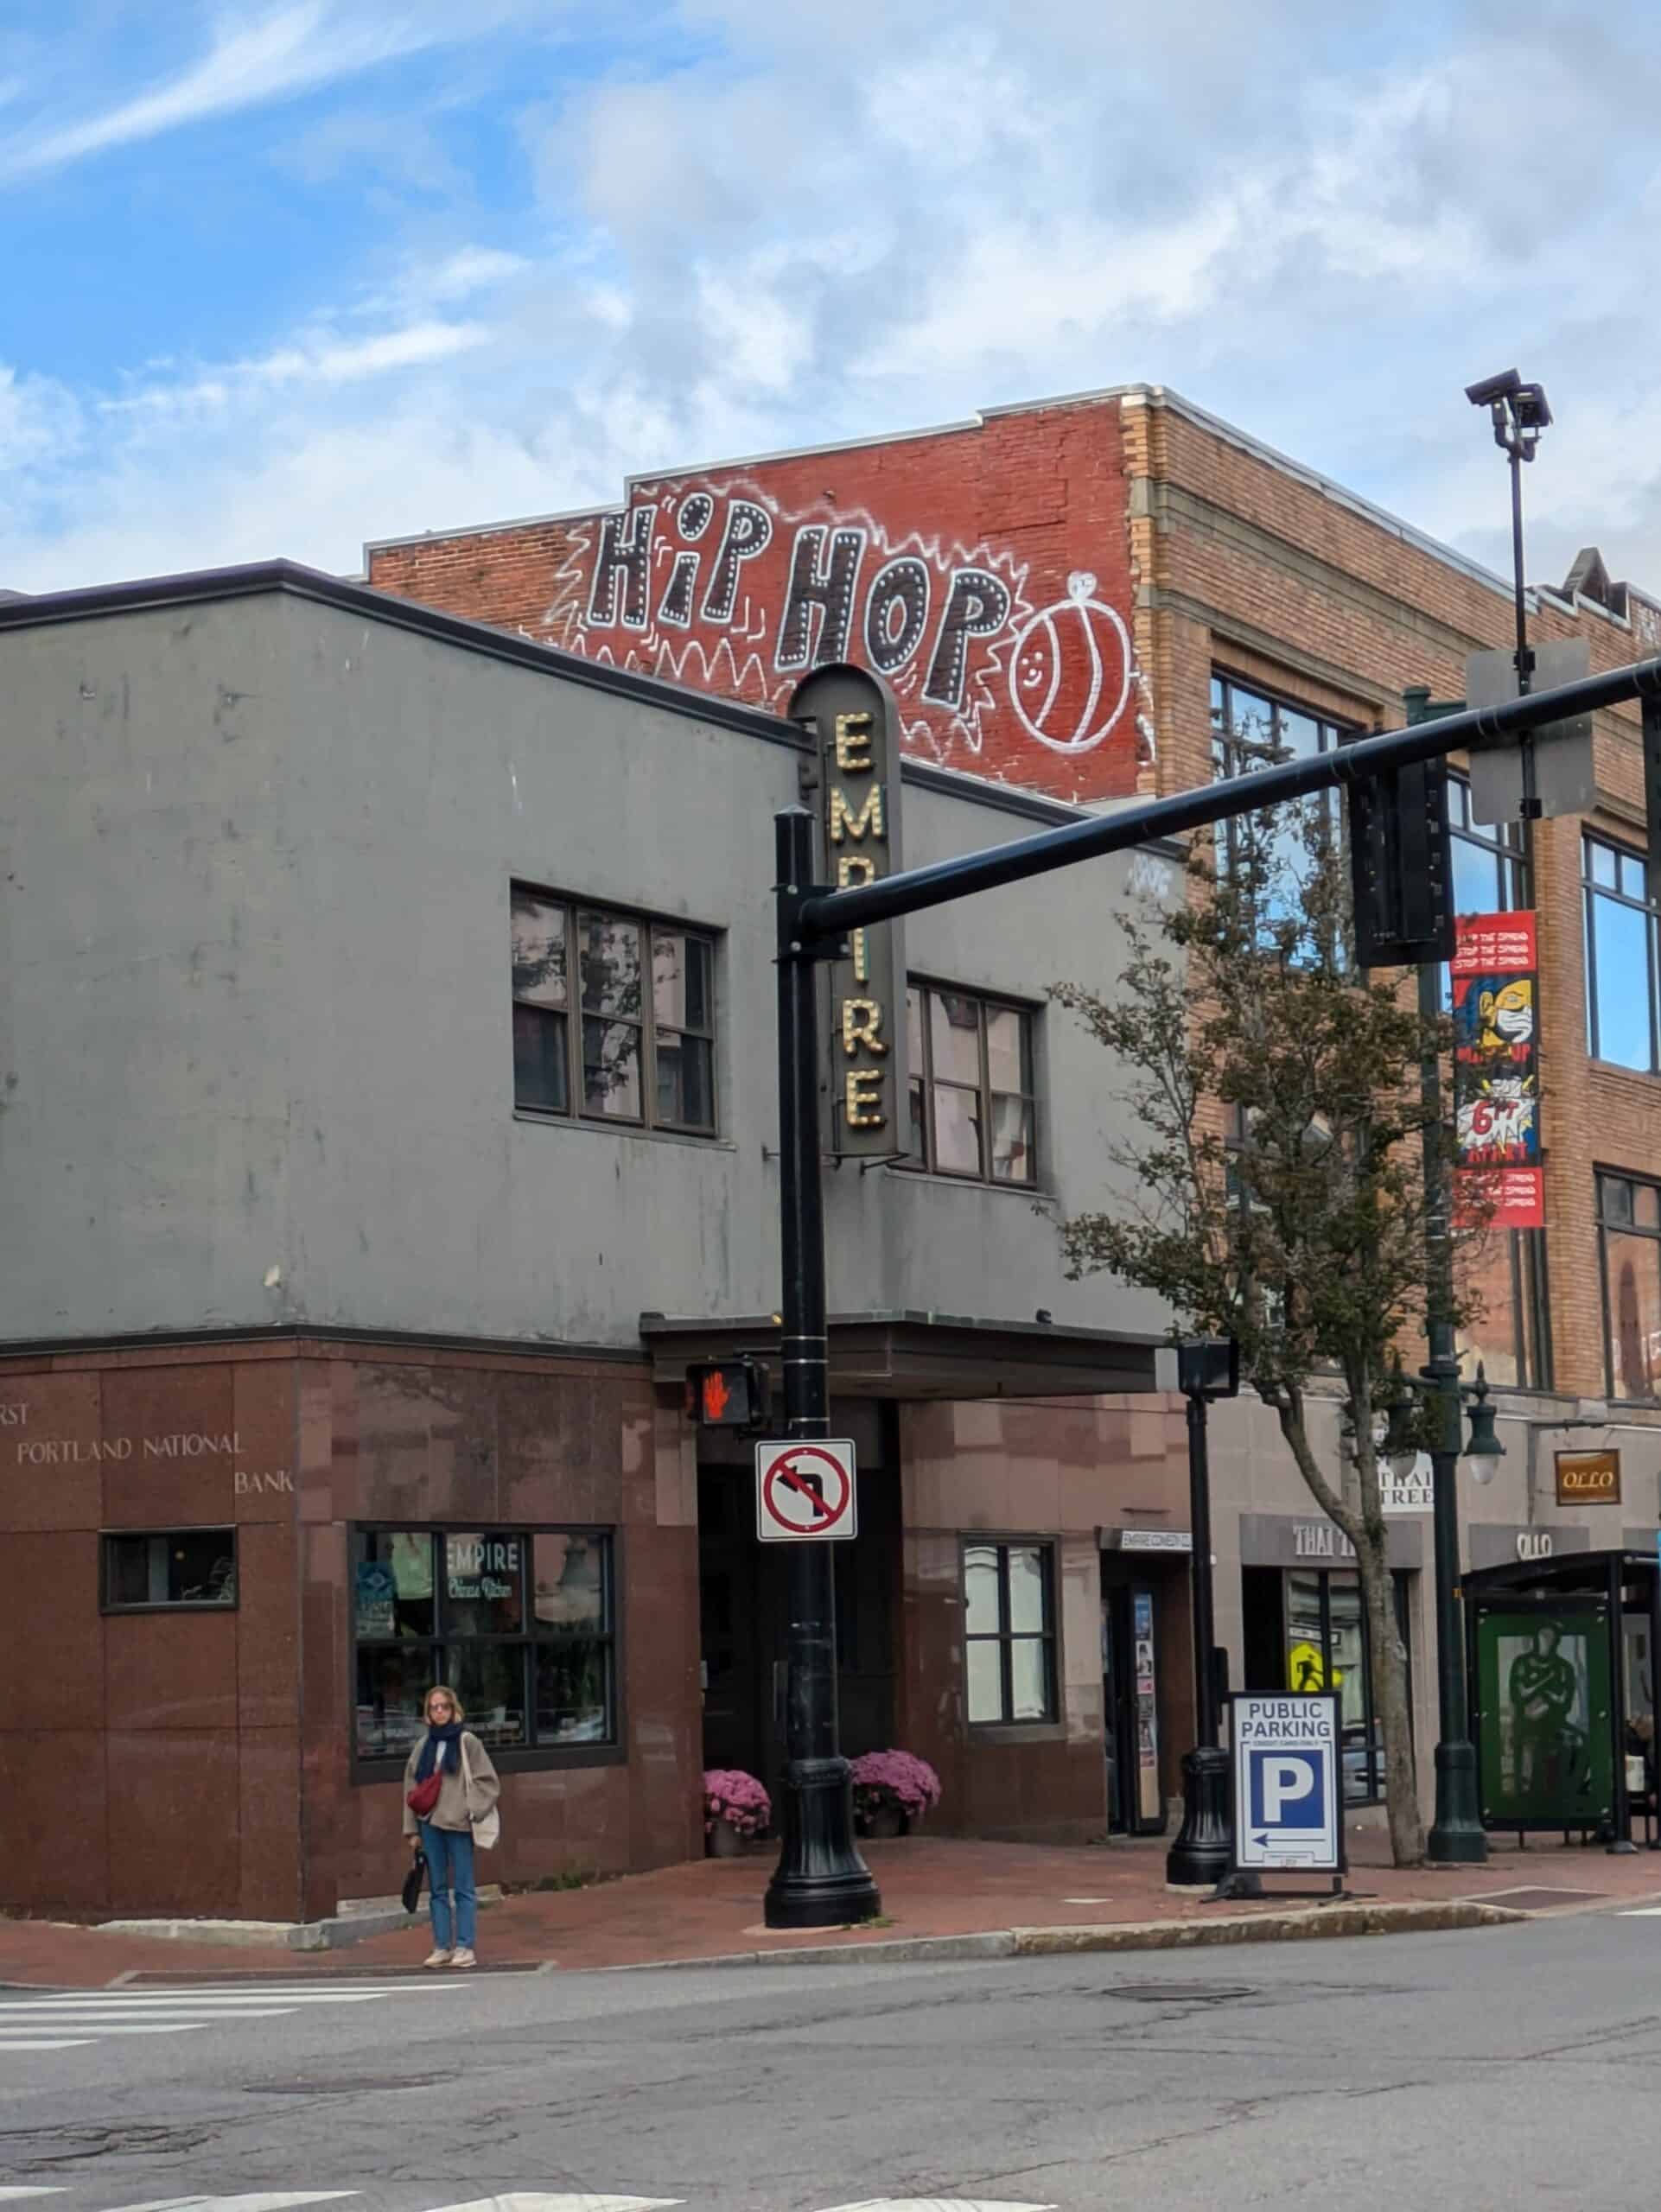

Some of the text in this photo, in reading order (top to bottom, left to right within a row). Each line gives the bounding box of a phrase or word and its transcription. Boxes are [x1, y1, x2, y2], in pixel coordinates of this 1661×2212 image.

[775, 524, 1012, 709] HOP
[16, 1431, 246, 1465] PORTLAND NATIONAL
[234, 1471, 295, 1494] BANK
[1381, 1471, 1431, 1487] THAI
[1562, 1471, 1613, 1488] OLLO
[1294, 1526, 1333, 1555] THAI
[447, 1542, 519, 1571] EMPIRE
[1250, 1702, 1321, 1719] PUBLIC
[1242, 1720, 1330, 1738] PARKING
[1263, 1757, 1314, 1823] P
